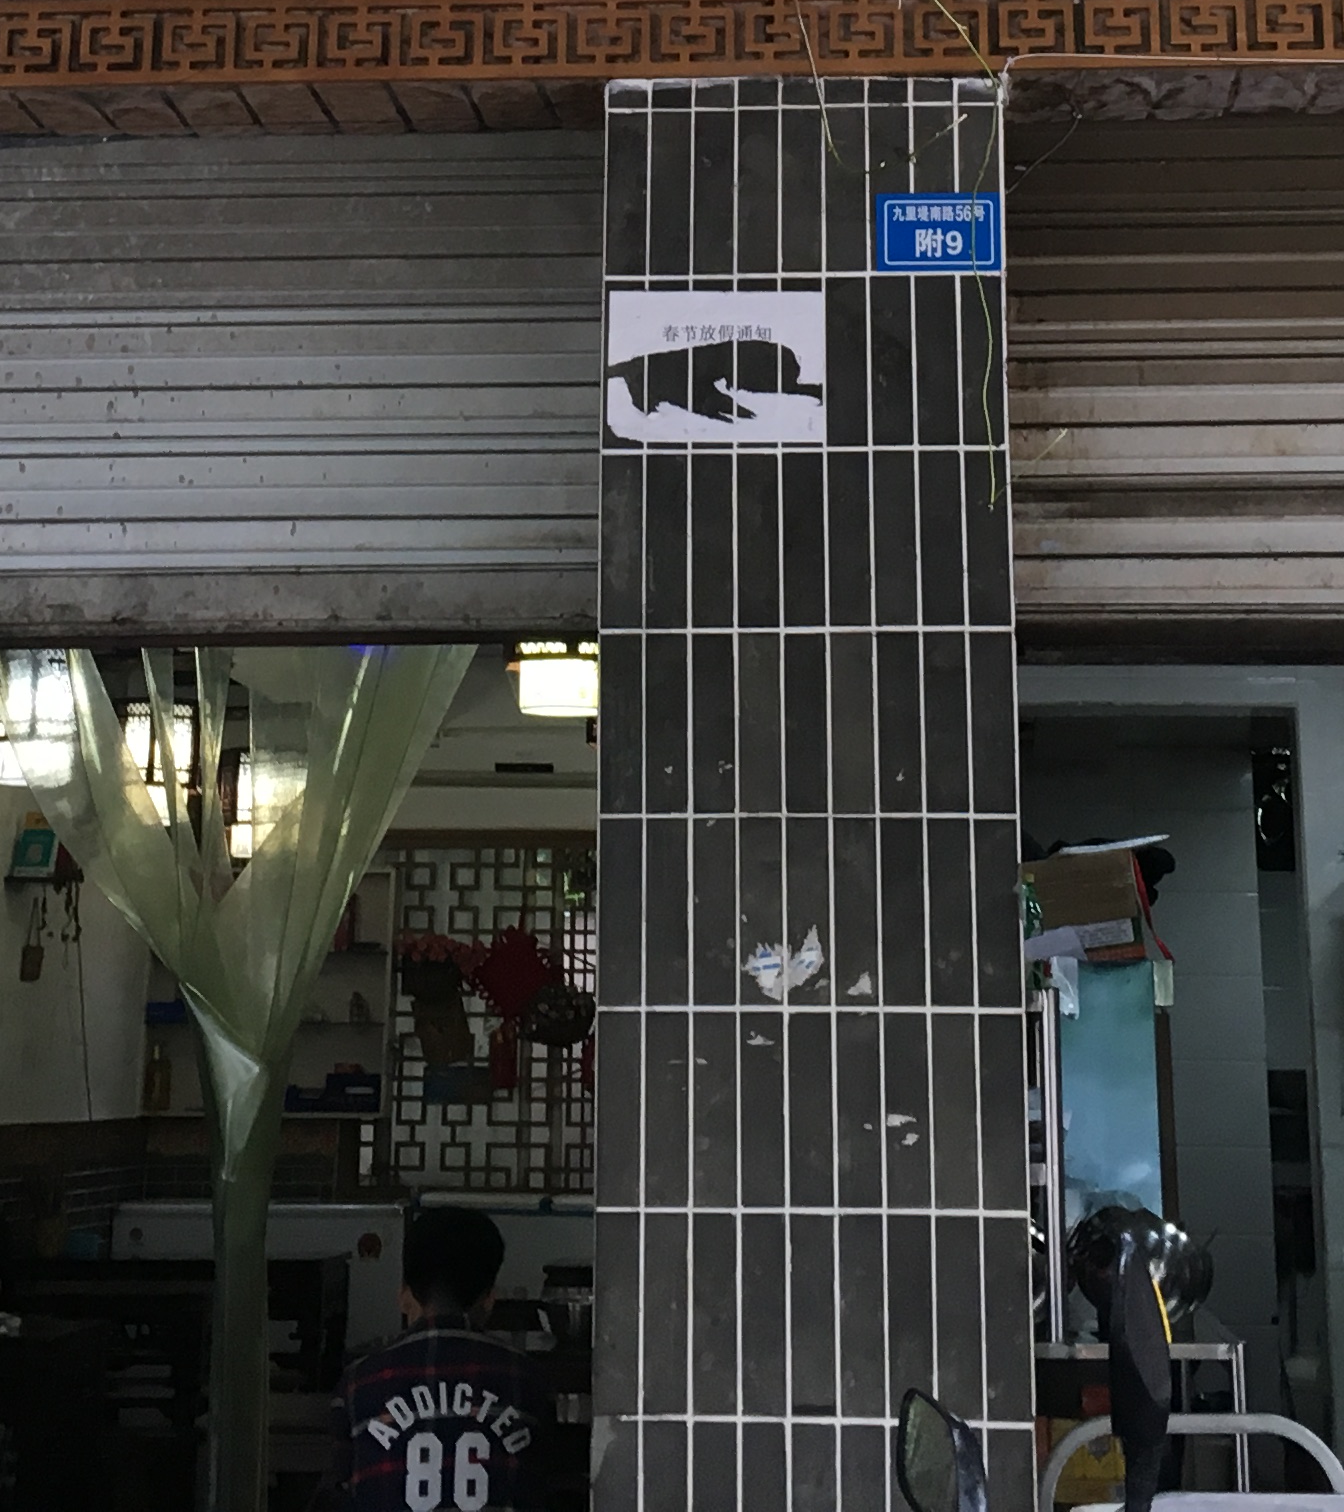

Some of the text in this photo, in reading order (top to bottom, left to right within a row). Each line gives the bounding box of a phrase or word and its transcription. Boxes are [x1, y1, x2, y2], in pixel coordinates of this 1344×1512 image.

[915, 228, 963, 258] 附9
[662, 324, 772, 342] 春节放假通知
[368, 1382, 531, 1452] ADDICTED
[405, 1432, 490, 1511] 86
